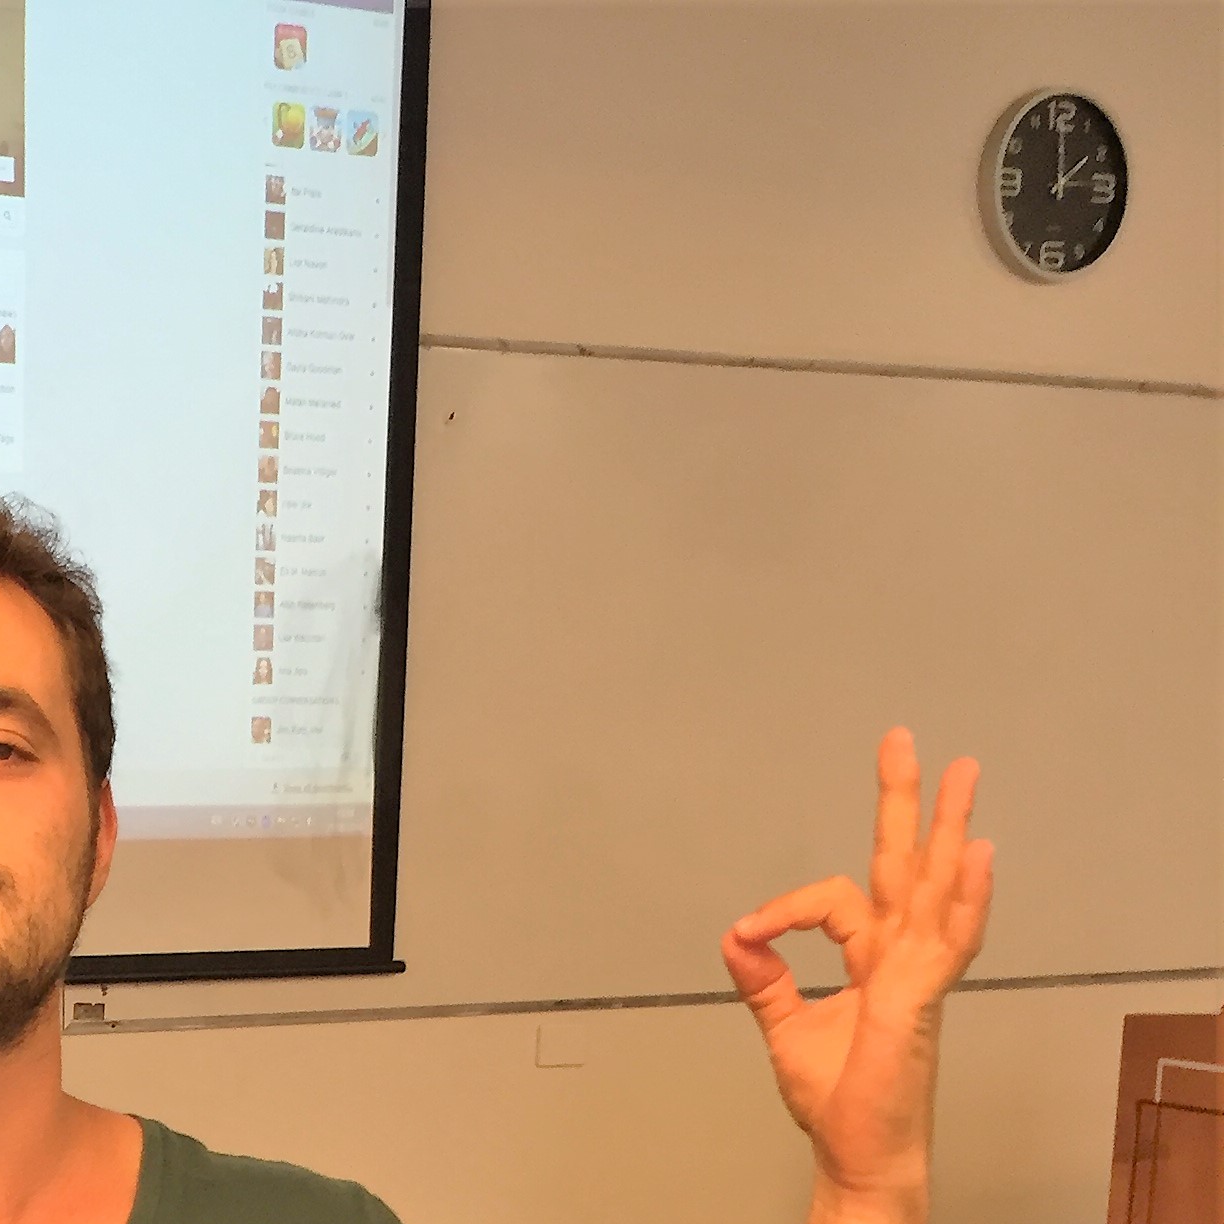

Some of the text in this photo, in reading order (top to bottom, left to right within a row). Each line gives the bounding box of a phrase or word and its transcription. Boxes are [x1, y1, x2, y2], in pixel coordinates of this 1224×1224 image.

[1048, 100, 1076, 132] 12
[1090, 173, 1116, 204] 3
[1040, 240, 1065, 268] 6
